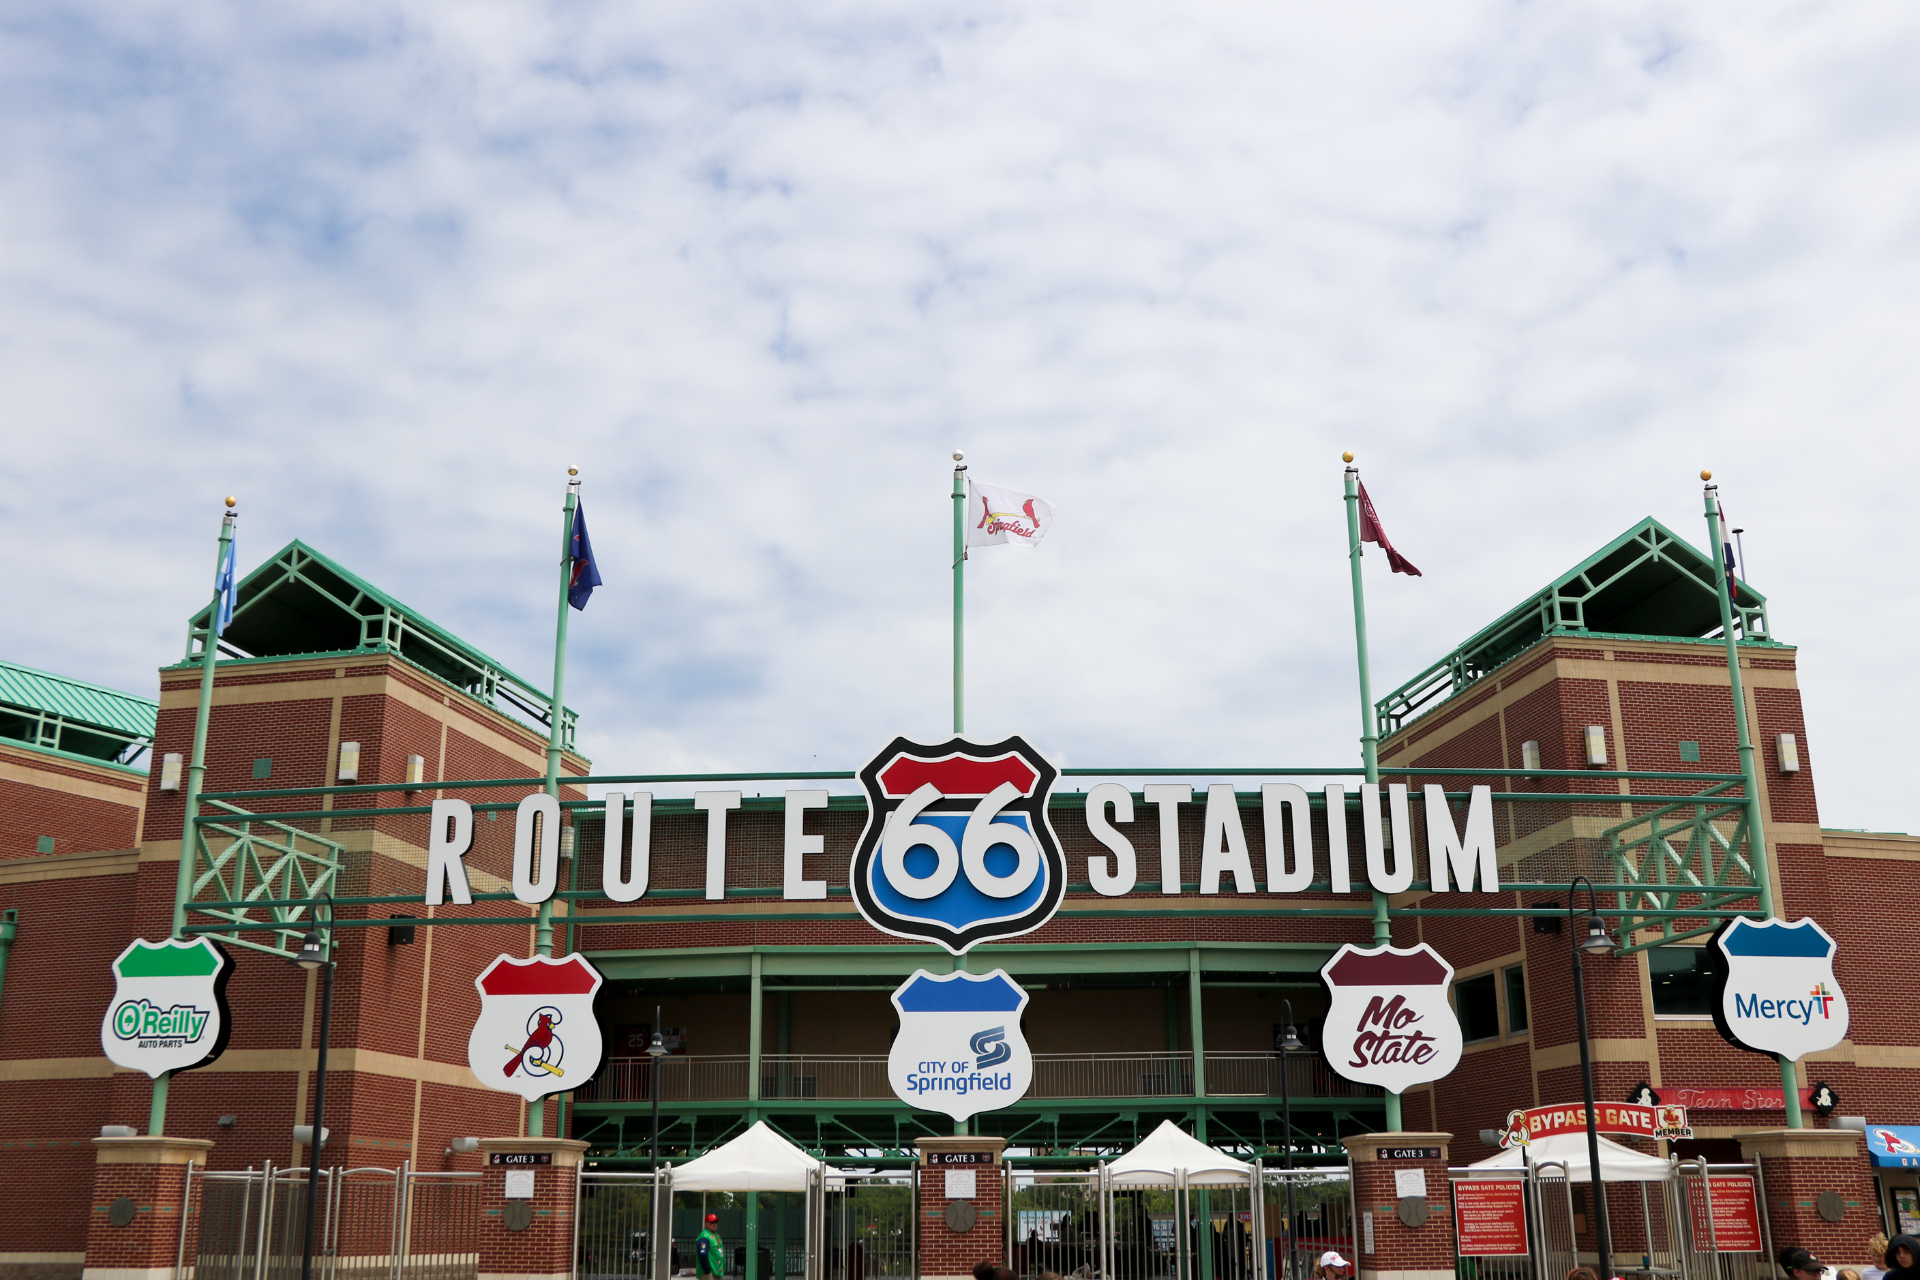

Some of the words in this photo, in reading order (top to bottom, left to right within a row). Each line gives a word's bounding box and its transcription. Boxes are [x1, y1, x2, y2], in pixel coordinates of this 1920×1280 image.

[425, 790, 829, 905] ROUTE
[881, 781, 1041, 900] 66
[1085, 783, 1500, 897] STADIUM
[1356, 994, 1424, 1032] Mo
[1735, 993, 1813, 1026] Mercy
[114, 999, 209, 1042] O'Reilly
[138, 1040, 157, 1049] AUTO
[159, 1039, 183, 1048] PARTS
[1348, 1030, 1439, 1068] State
[918, 1061, 946, 1073] CITY
[951, 1061, 969, 1073] OF
[906, 1072, 1011, 1095] Springfield
[1677, 1088, 1733, 1109] Team
[1743, 1089, 1786, 1110] Stor
[1605, 1108, 1653, 1129] GATE
[1655, 1127, 1692, 1138] MEMBER
[505, 1155, 527, 1164] GATE
[529, 1155, 535, 1164] 3
[945, 1154, 968, 1163] GATE
[970, 1154, 976, 1163] 3
[1394, 1149, 1416, 1158] GATE
[1418, 1149, 1424, 1158] 3
